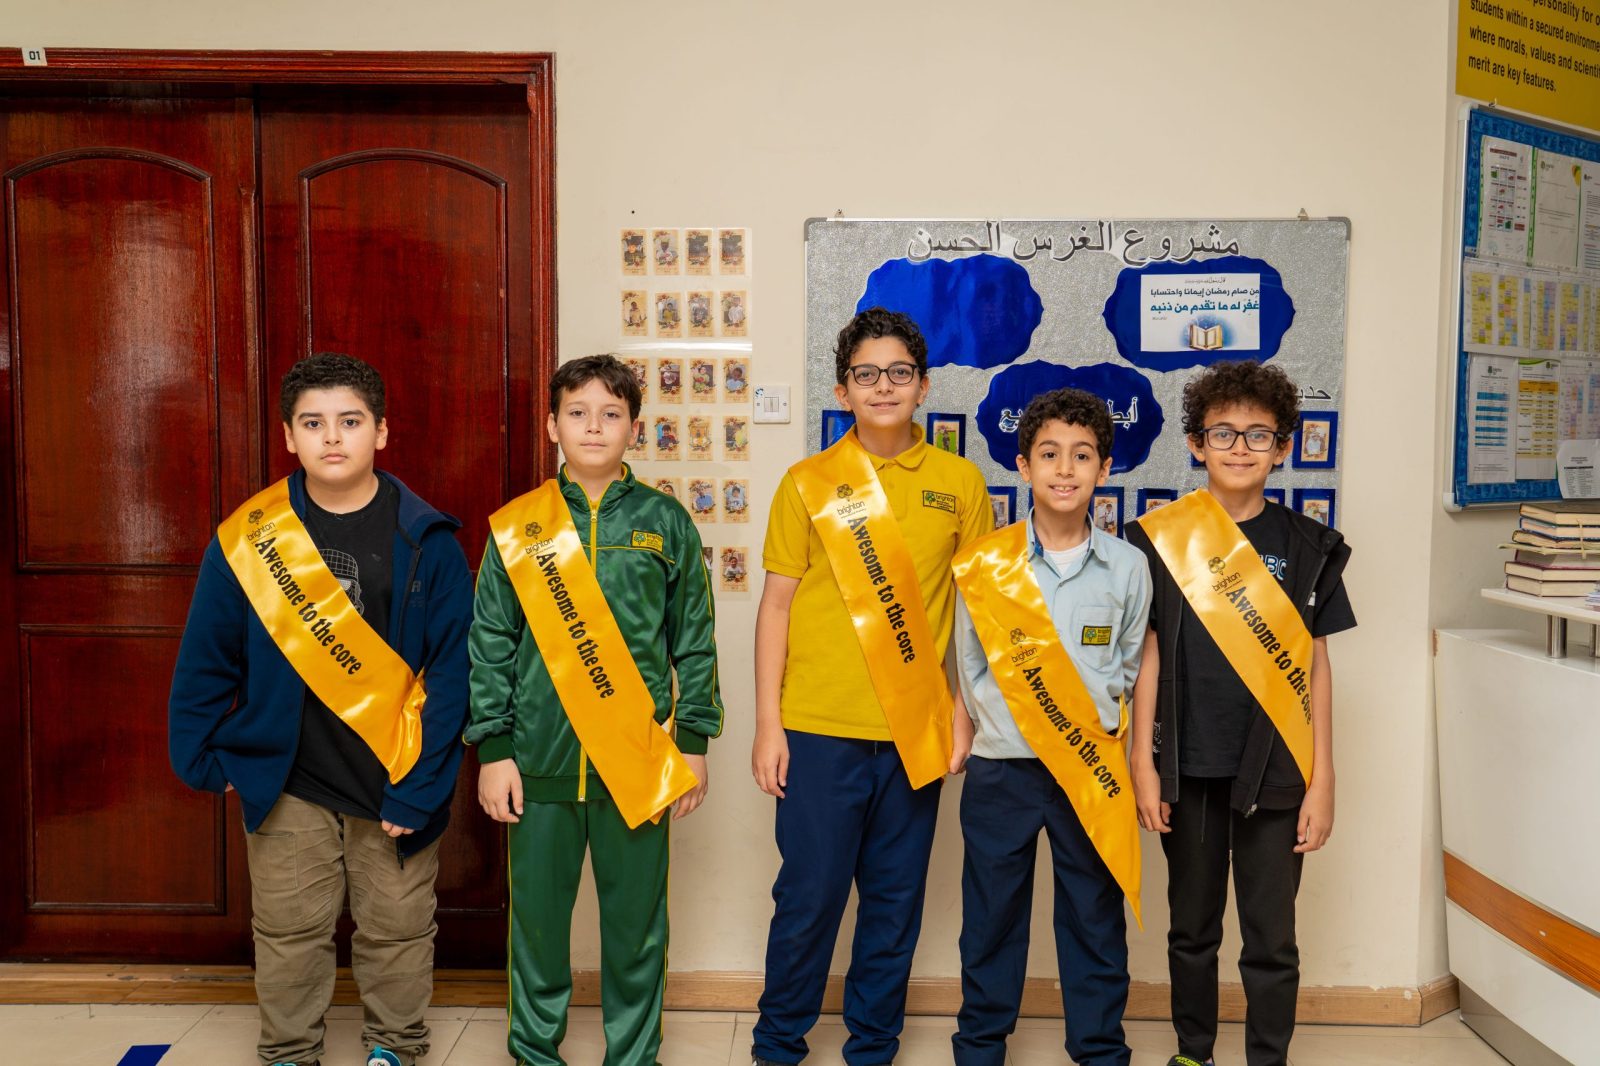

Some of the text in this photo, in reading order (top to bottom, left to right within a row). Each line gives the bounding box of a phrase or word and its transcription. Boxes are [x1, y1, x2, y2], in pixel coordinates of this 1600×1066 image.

[1471, 0, 1504, 20] students
[1506, 9, 1528, 28] within
[1530, 18, 1534, 30] a
[1536, 20, 1564, 40] secured
[1582, 6, 1593, 23] for
[29, 51, 40, 60] 01
[1470, 26, 1495, 45] where
[1498, 35, 1528, 58] morals,
[1530, 45, 1556, 65] values
[1558, 55, 1572, 70] and
[1469, 54, 1557, 92] merit are key features.
[908, 219, 1239, 265] مشروع الغرس الحسن
[1206, 288, 1230, 297] رمضان
[1231, 288, 1248, 297] صام
[1150, 302, 1172, 314] ذنبه
[1174, 303, 1188, 313] من
[1191, 300, 1216, 314] تقدم
[1218, 301, 1228, 310] ما
[1230, 301, 1240, 310] له
[837, 500, 865, 516] brighton
[247, 522, 275, 541] brighton
[525, 537, 554, 554] brighton
[848, 516, 887, 586] Awesome
[537, 551, 579, 622] Awesome
[1212, 571, 1241, 592] brighton
[877, 584, 895, 603] to
[255, 537, 305, 606] Awesome
[298, 602, 318, 622] to
[310, 617, 336, 647] the
[330, 642, 362, 675] core
[885, 602, 906, 630] the
[568, 620, 586, 640] to
[576, 638, 599, 667] the
[896, 629, 916, 664] core
[1011, 647, 1037, 663] brighton
[1226, 586, 1281, 654] Awesome
[1274, 650, 1292, 671] to
[1286, 667, 1307, 696] the
[1301, 692, 1312, 725] core
[589, 665, 615, 699] core
[1022, 666, 1071, 732] Awesome
[1065, 727, 1083, 747] to
[1078, 741, 1100, 767] the
[1093, 764, 1121, 798] core
